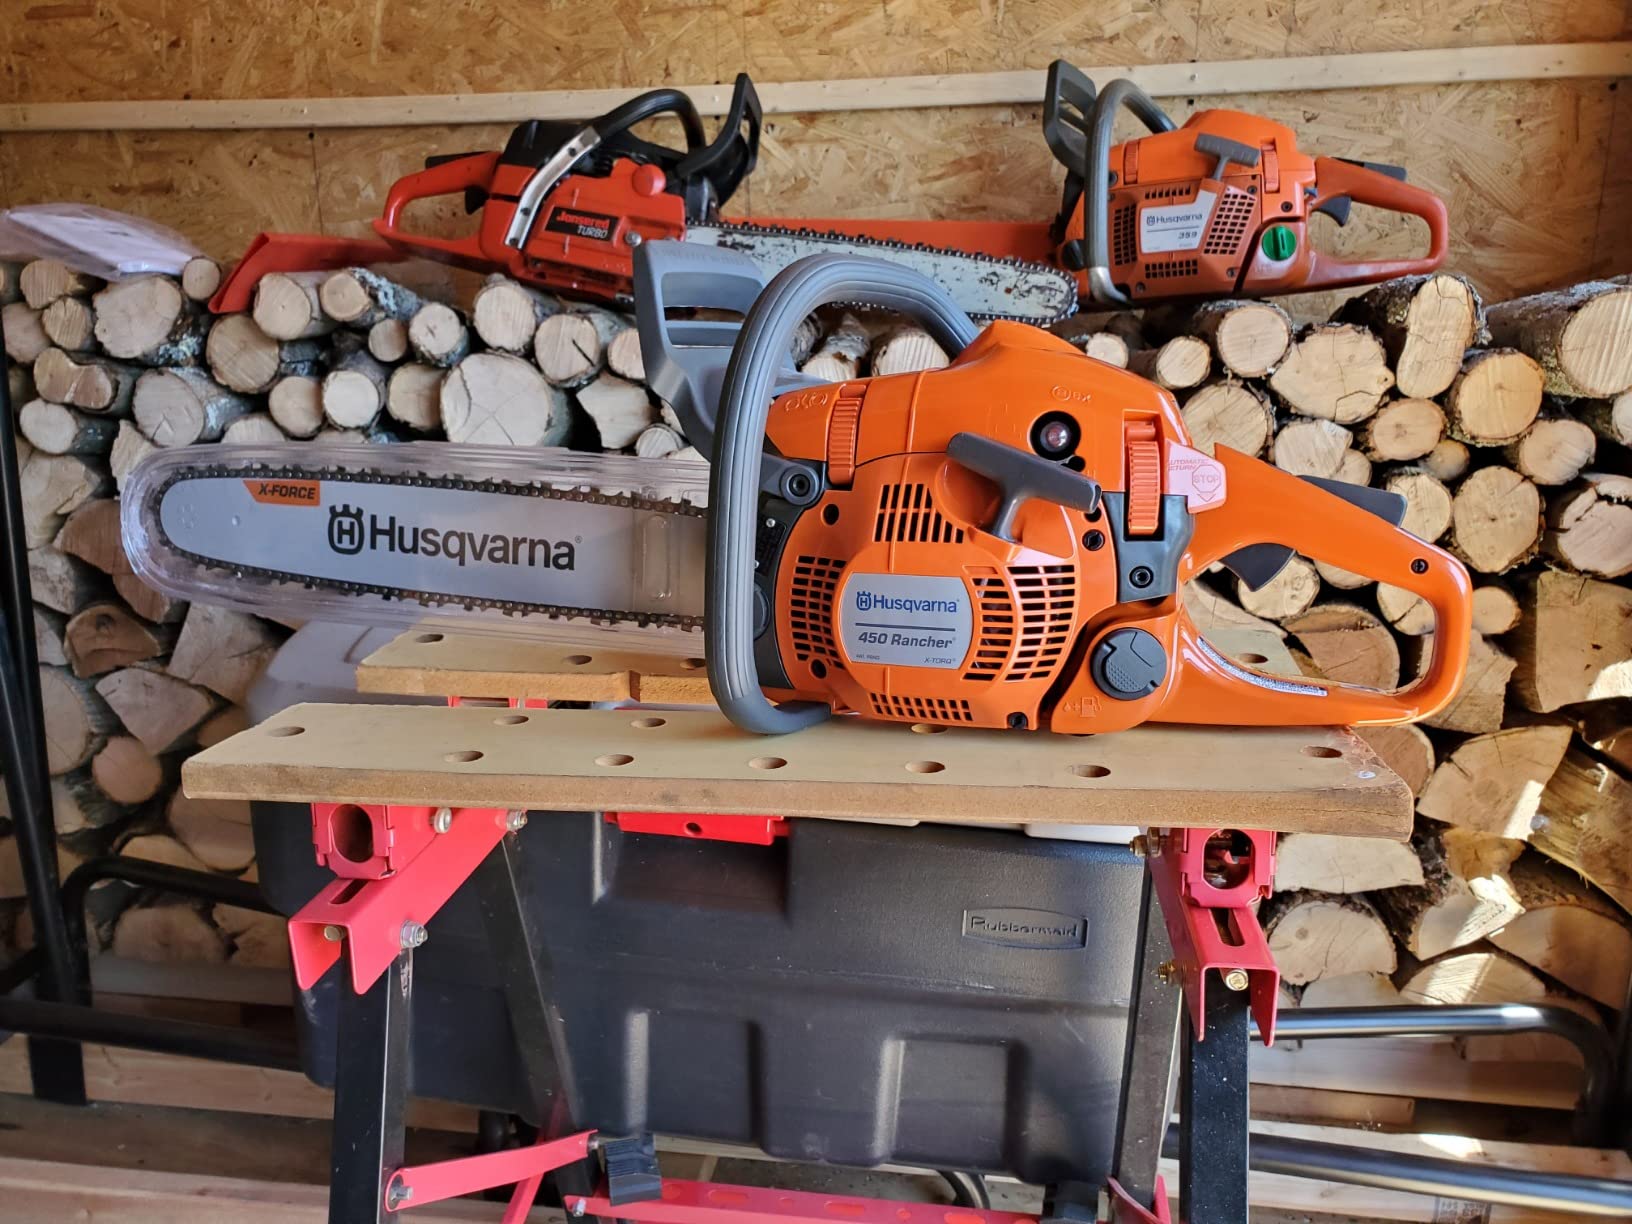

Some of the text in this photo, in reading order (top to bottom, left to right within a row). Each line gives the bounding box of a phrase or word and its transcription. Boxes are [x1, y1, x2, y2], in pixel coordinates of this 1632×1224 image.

[1156, 213, 1203, 224] Husqvarna
[577, 224, 609, 239] TURBO
[1193, 475, 1219, 483] STOP
[258, 483, 316, 500] X-FORCE
[370, 514, 576, 571] Husqvarna
[873, 594, 957, 613] Husqvarna
[858, 631, 953, 649] 450 Rancher
[924, 657, 952, 665] X-TORQ
[971, 916, 1077, 937] Rubbermaid
